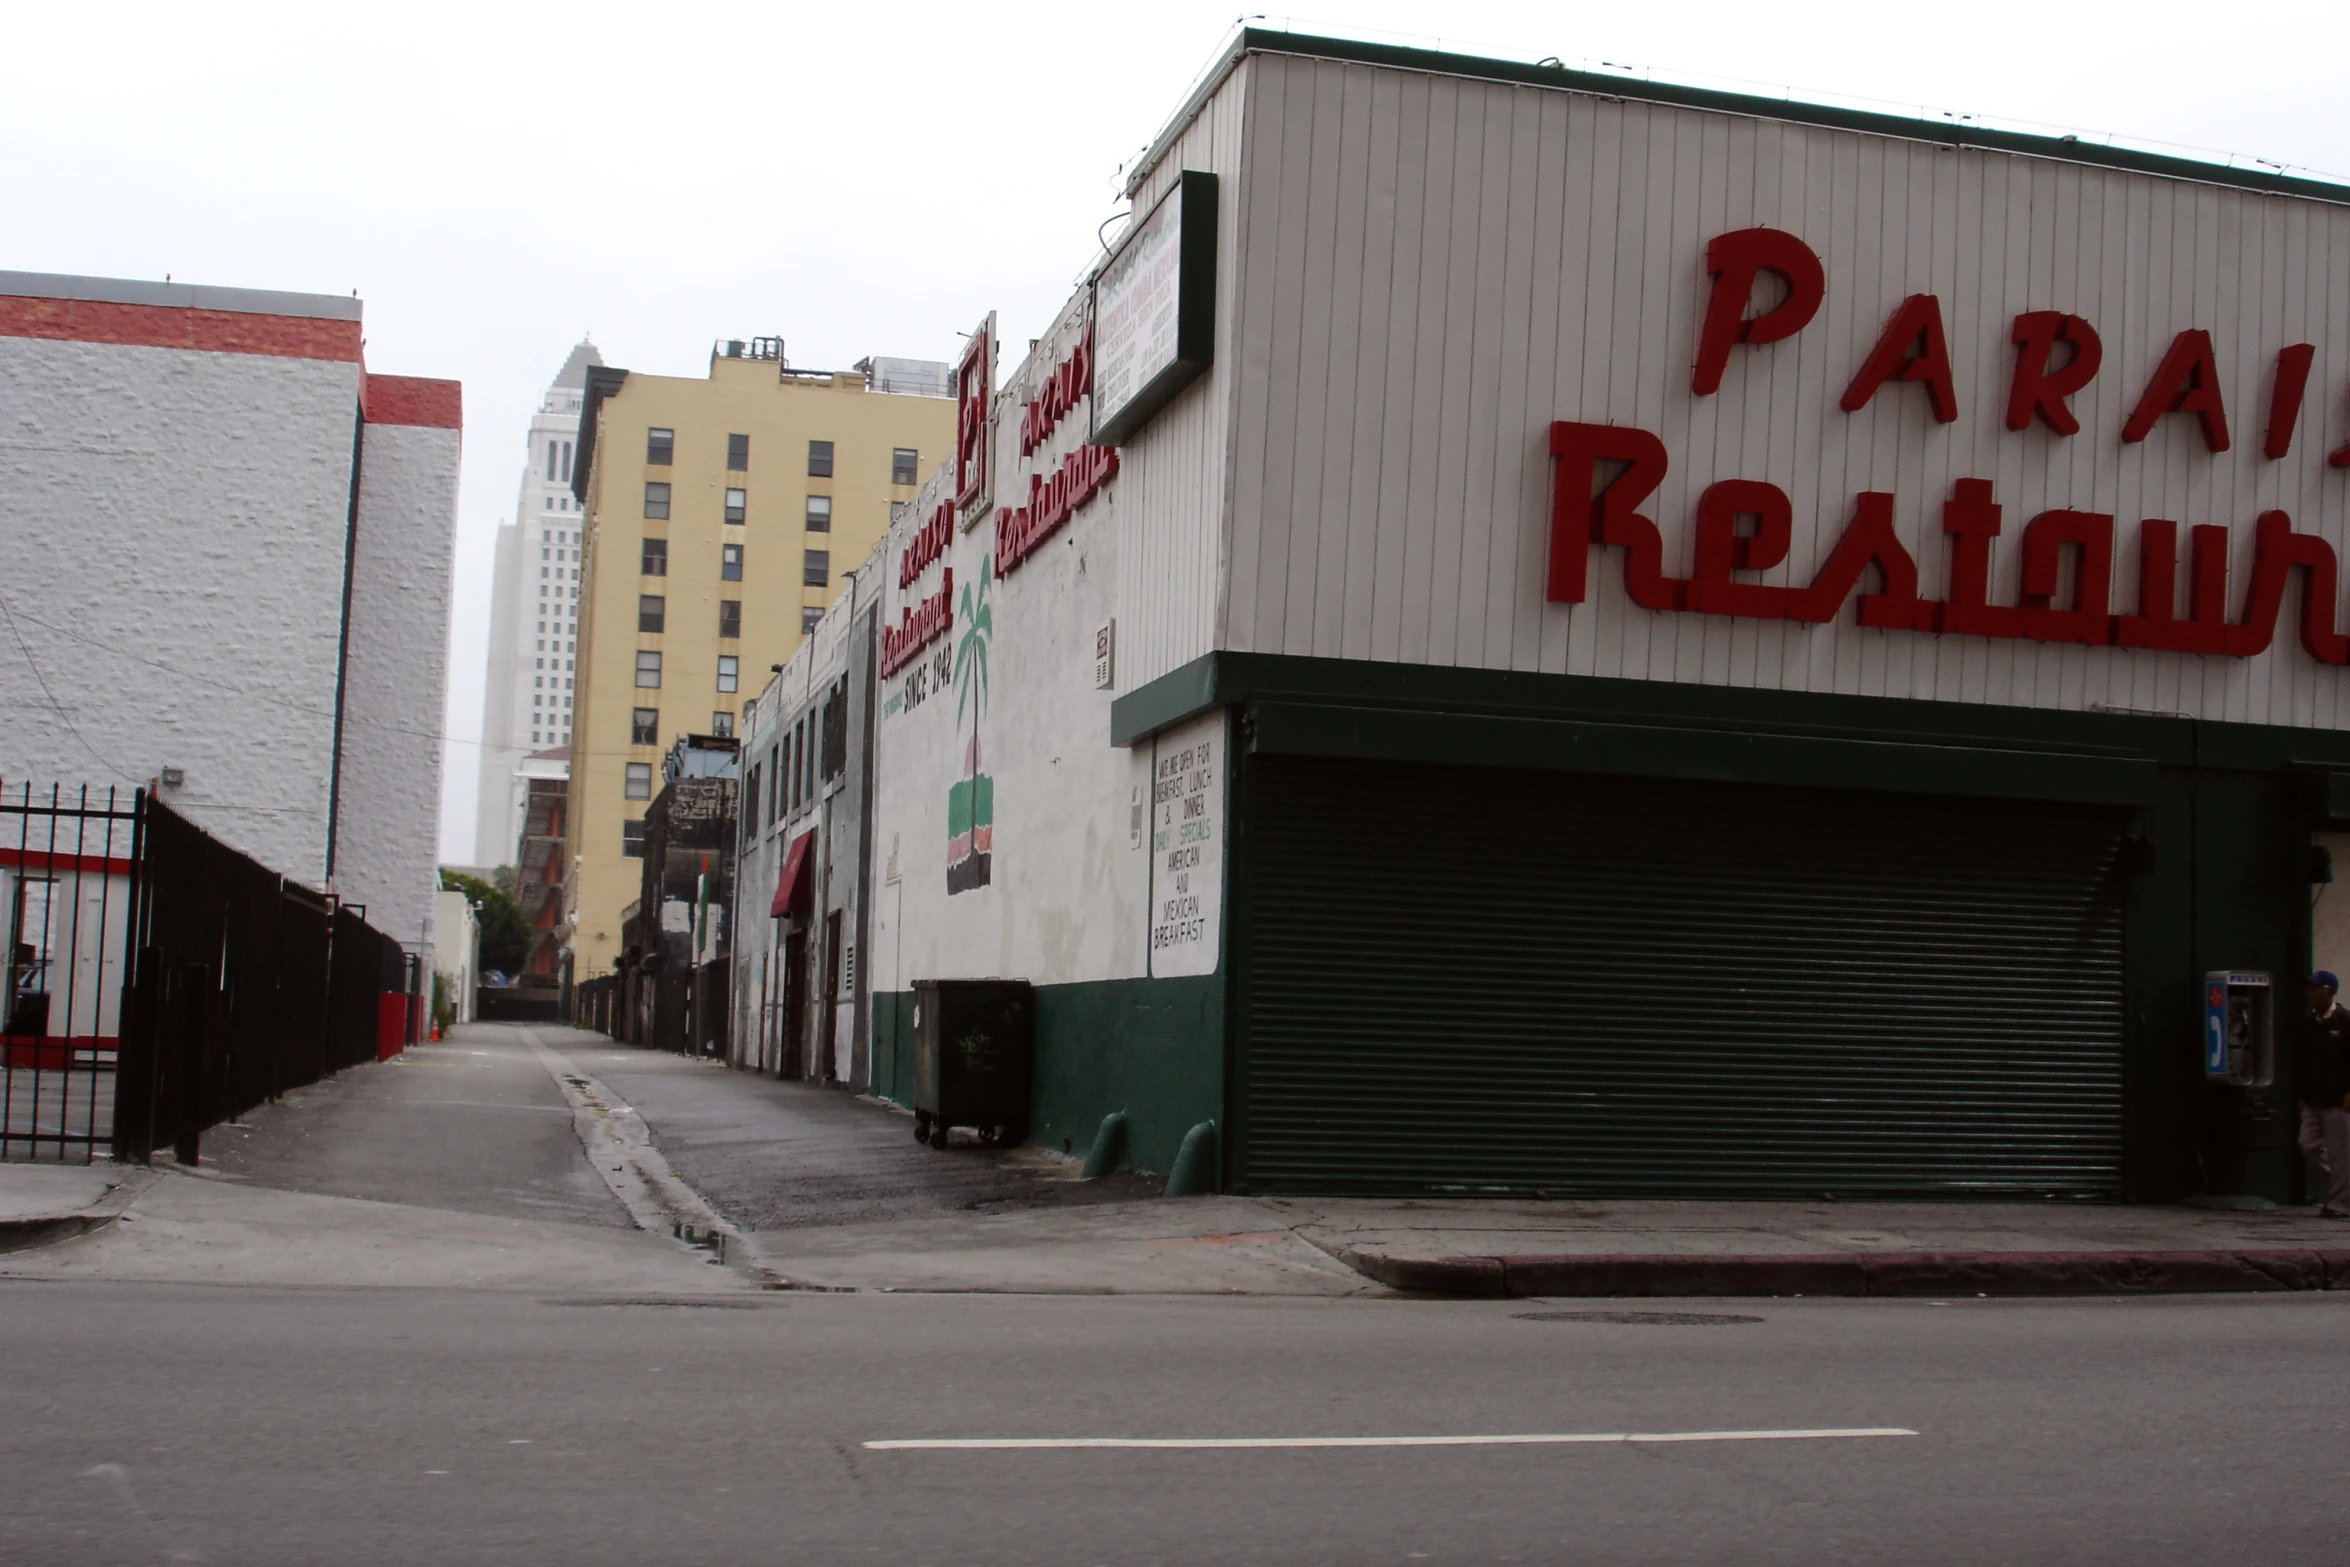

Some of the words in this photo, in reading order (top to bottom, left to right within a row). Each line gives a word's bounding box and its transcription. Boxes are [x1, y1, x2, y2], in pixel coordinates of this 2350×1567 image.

[1691, 227, 2350, 468] PARAI
[904, 662, 927, 714] SINCE
[932, 642, 951, 695] 1942
[1158, 757, 1170, 779] WE
[1180, 750, 1194, 773] OPEN
[1198, 743, 1211, 766] FOR
[1190, 767, 1212, 792] LUNCH
[1165, 805, 1171, 825] &
[1184, 794, 1205, 820] DINNER
[1180, 818, 1211, 846] SPECIALS
[1167, 847, 1200, 872] AMERICAN
[1176, 874, 1189, 895] AND
[1163, 895, 1199, 922] MEXICAN
[1154, 918, 1204, 950] BREAKFAST
